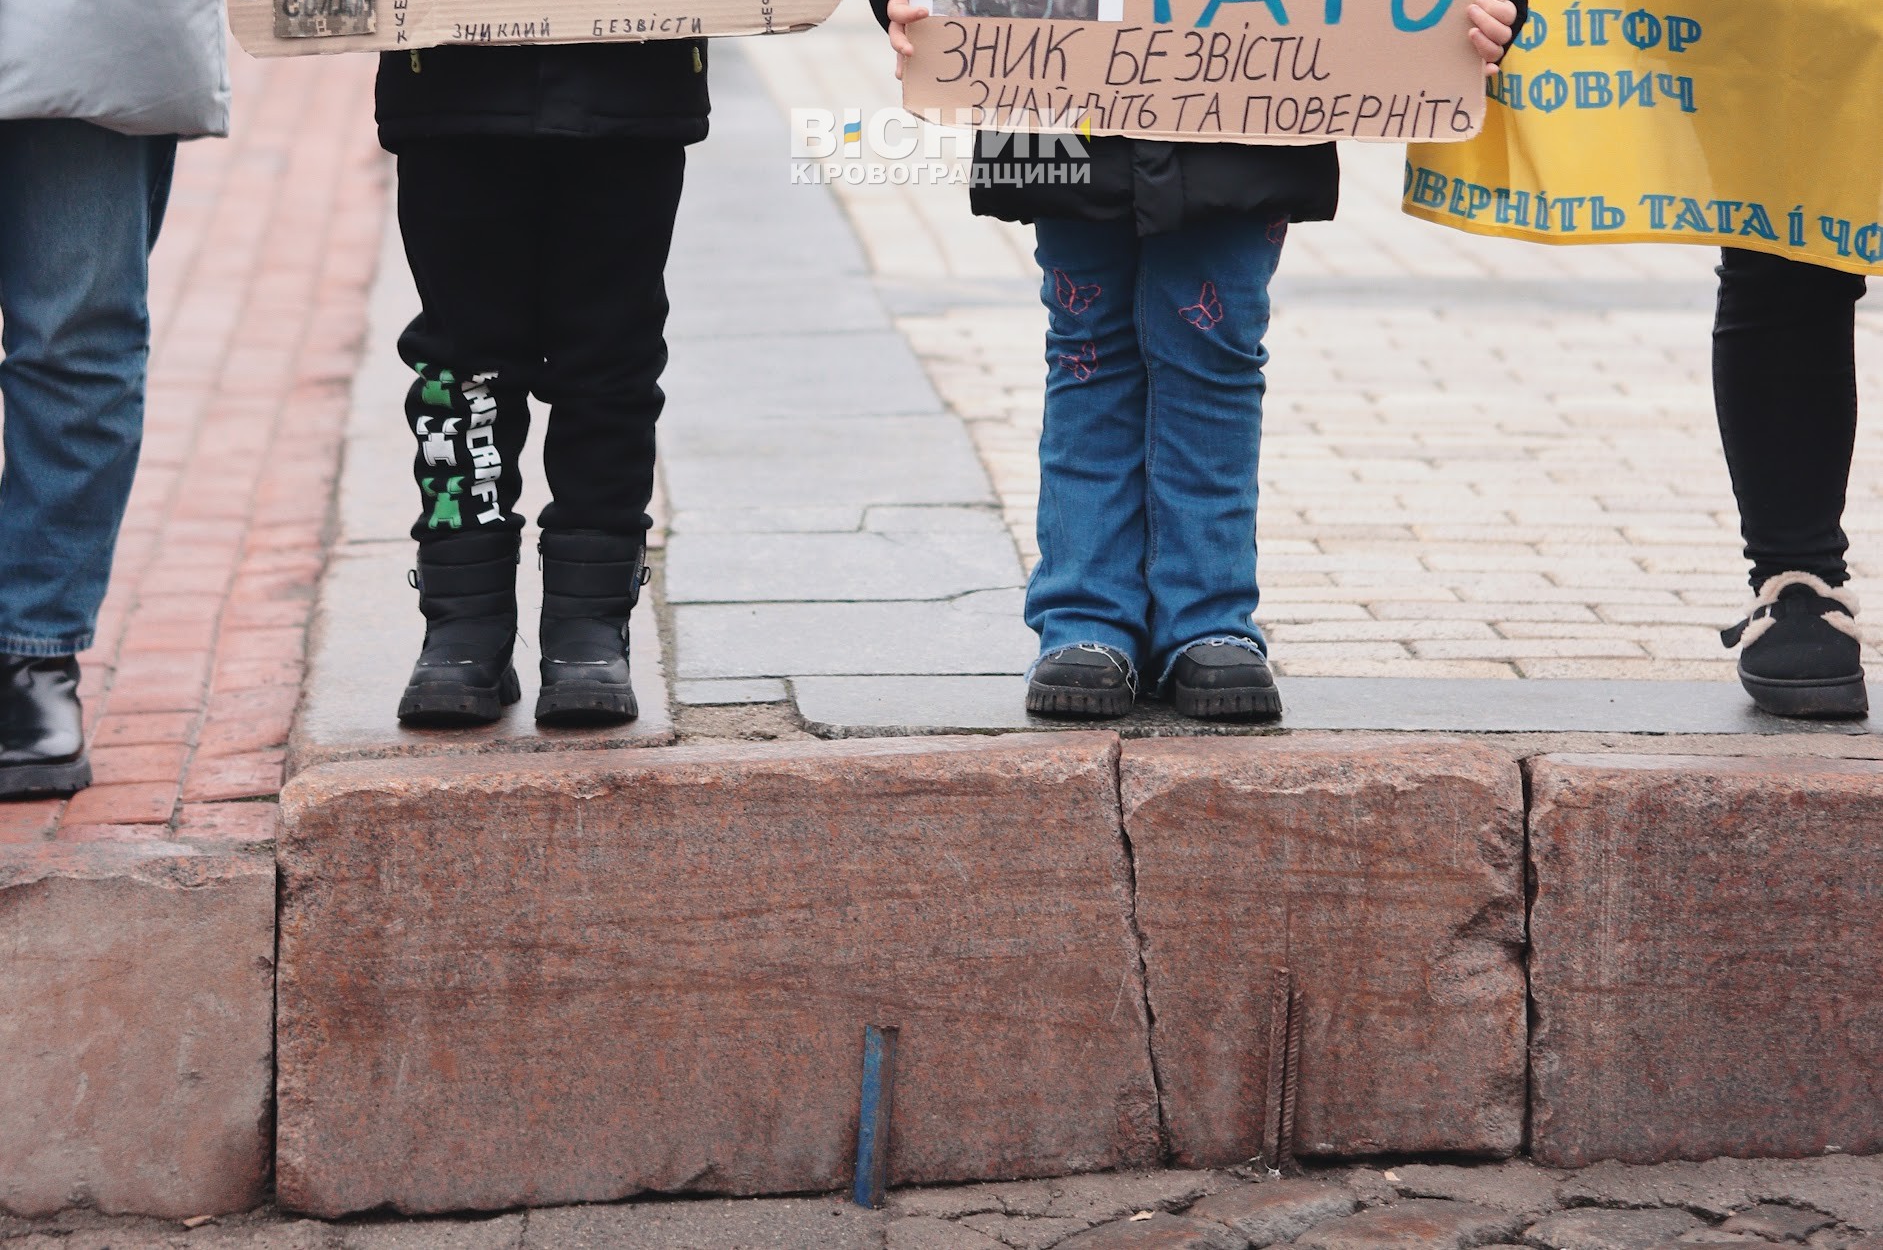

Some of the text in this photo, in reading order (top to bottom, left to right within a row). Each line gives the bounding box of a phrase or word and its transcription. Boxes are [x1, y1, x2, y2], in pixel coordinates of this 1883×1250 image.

[452, 13, 703, 42] ЗНИКЛИЙ БЕЗВІСТИ
[1562, 1, 1702, 53] ІГОР
[936, 21, 1084, 83] ЗНИК
[1172, 92, 1222, 132] ТА
[1637, 193, 1780, 242] ТАТА
